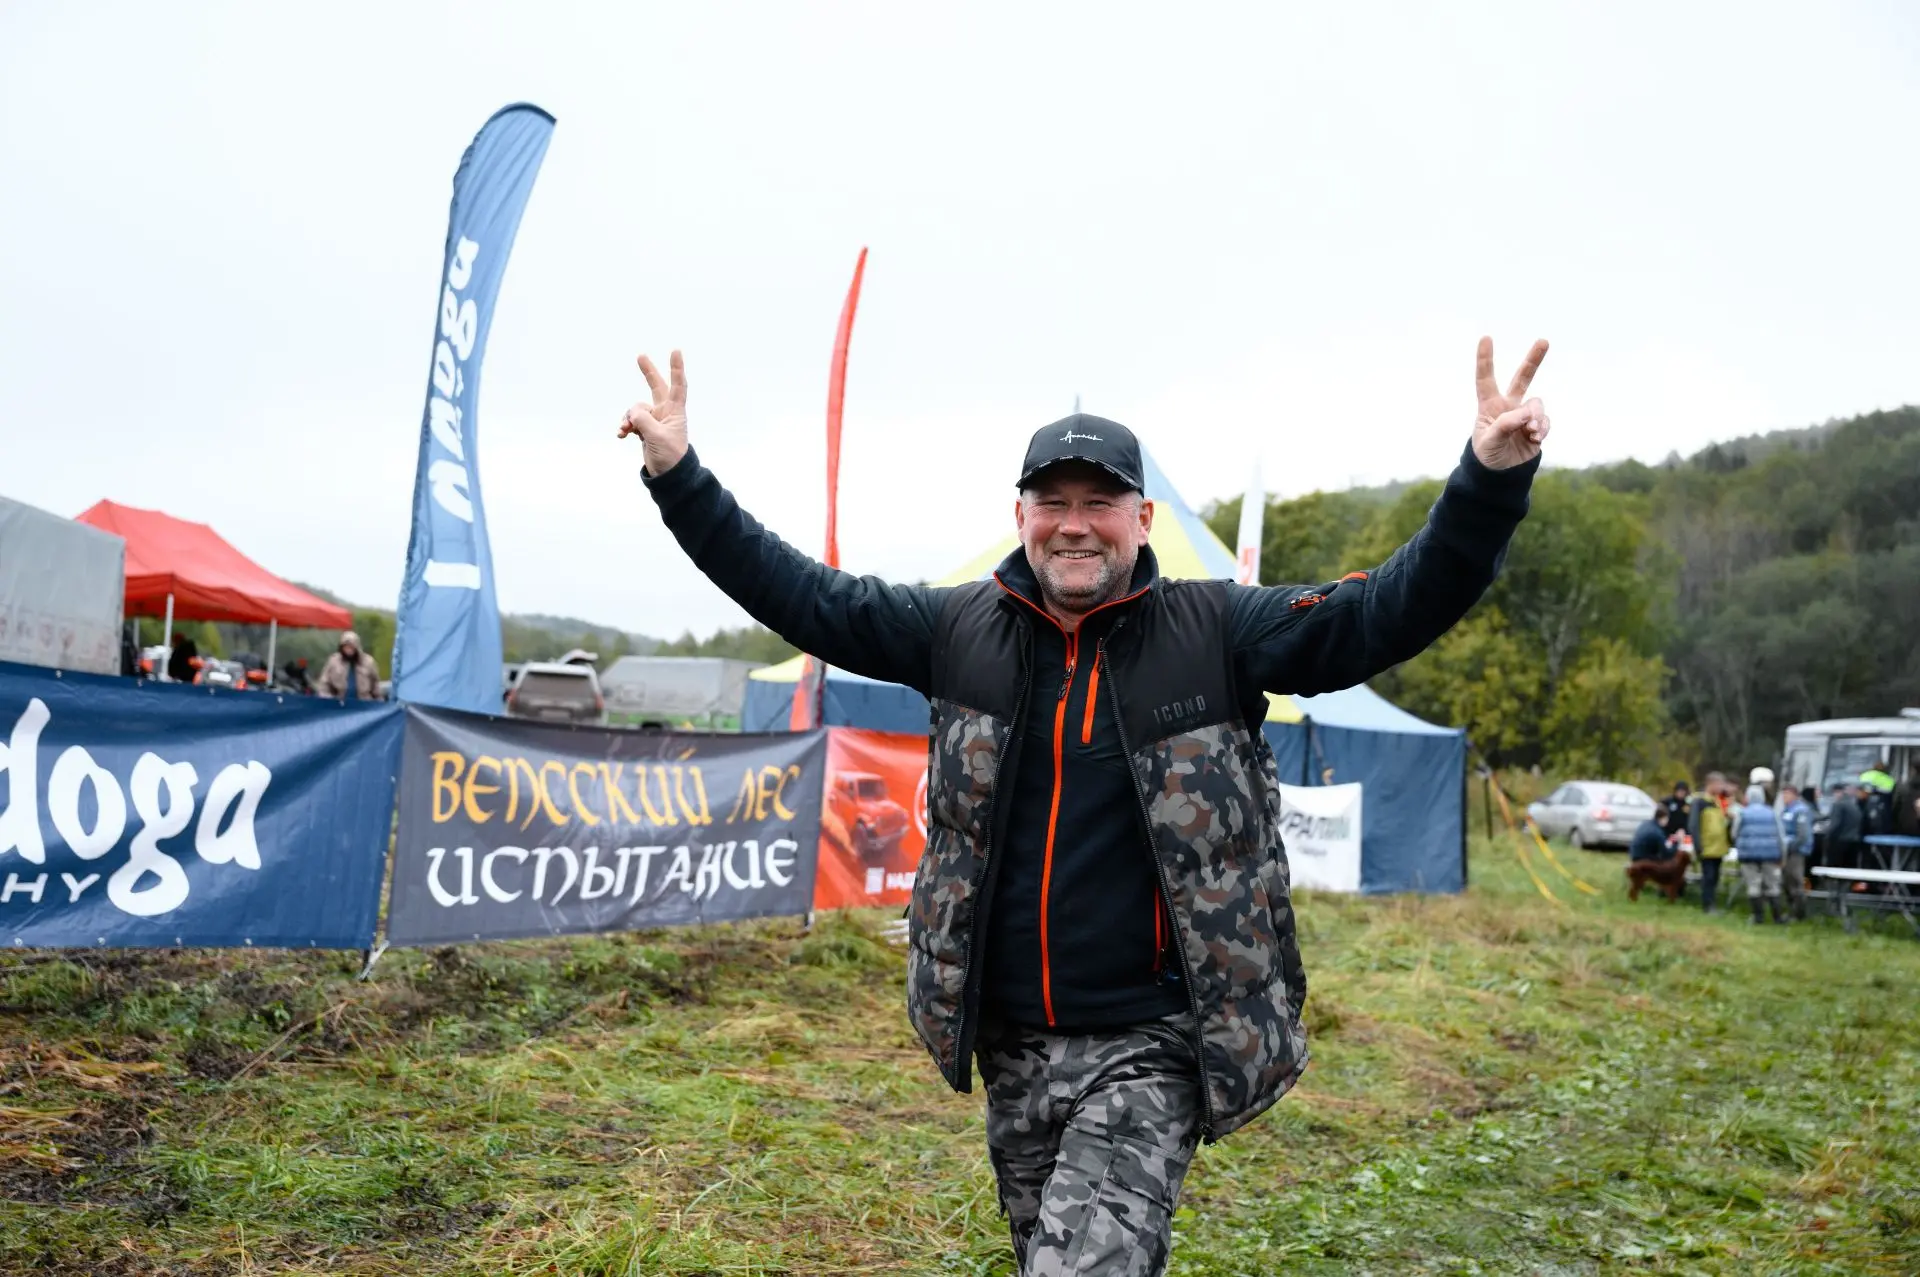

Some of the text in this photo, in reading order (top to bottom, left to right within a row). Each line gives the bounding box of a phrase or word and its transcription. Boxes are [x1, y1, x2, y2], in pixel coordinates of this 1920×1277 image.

[430, 748, 802, 831] ВЕПССКИЙ ЛЕС
[426, 839, 799, 907] ИСПЫТАНИЕ
